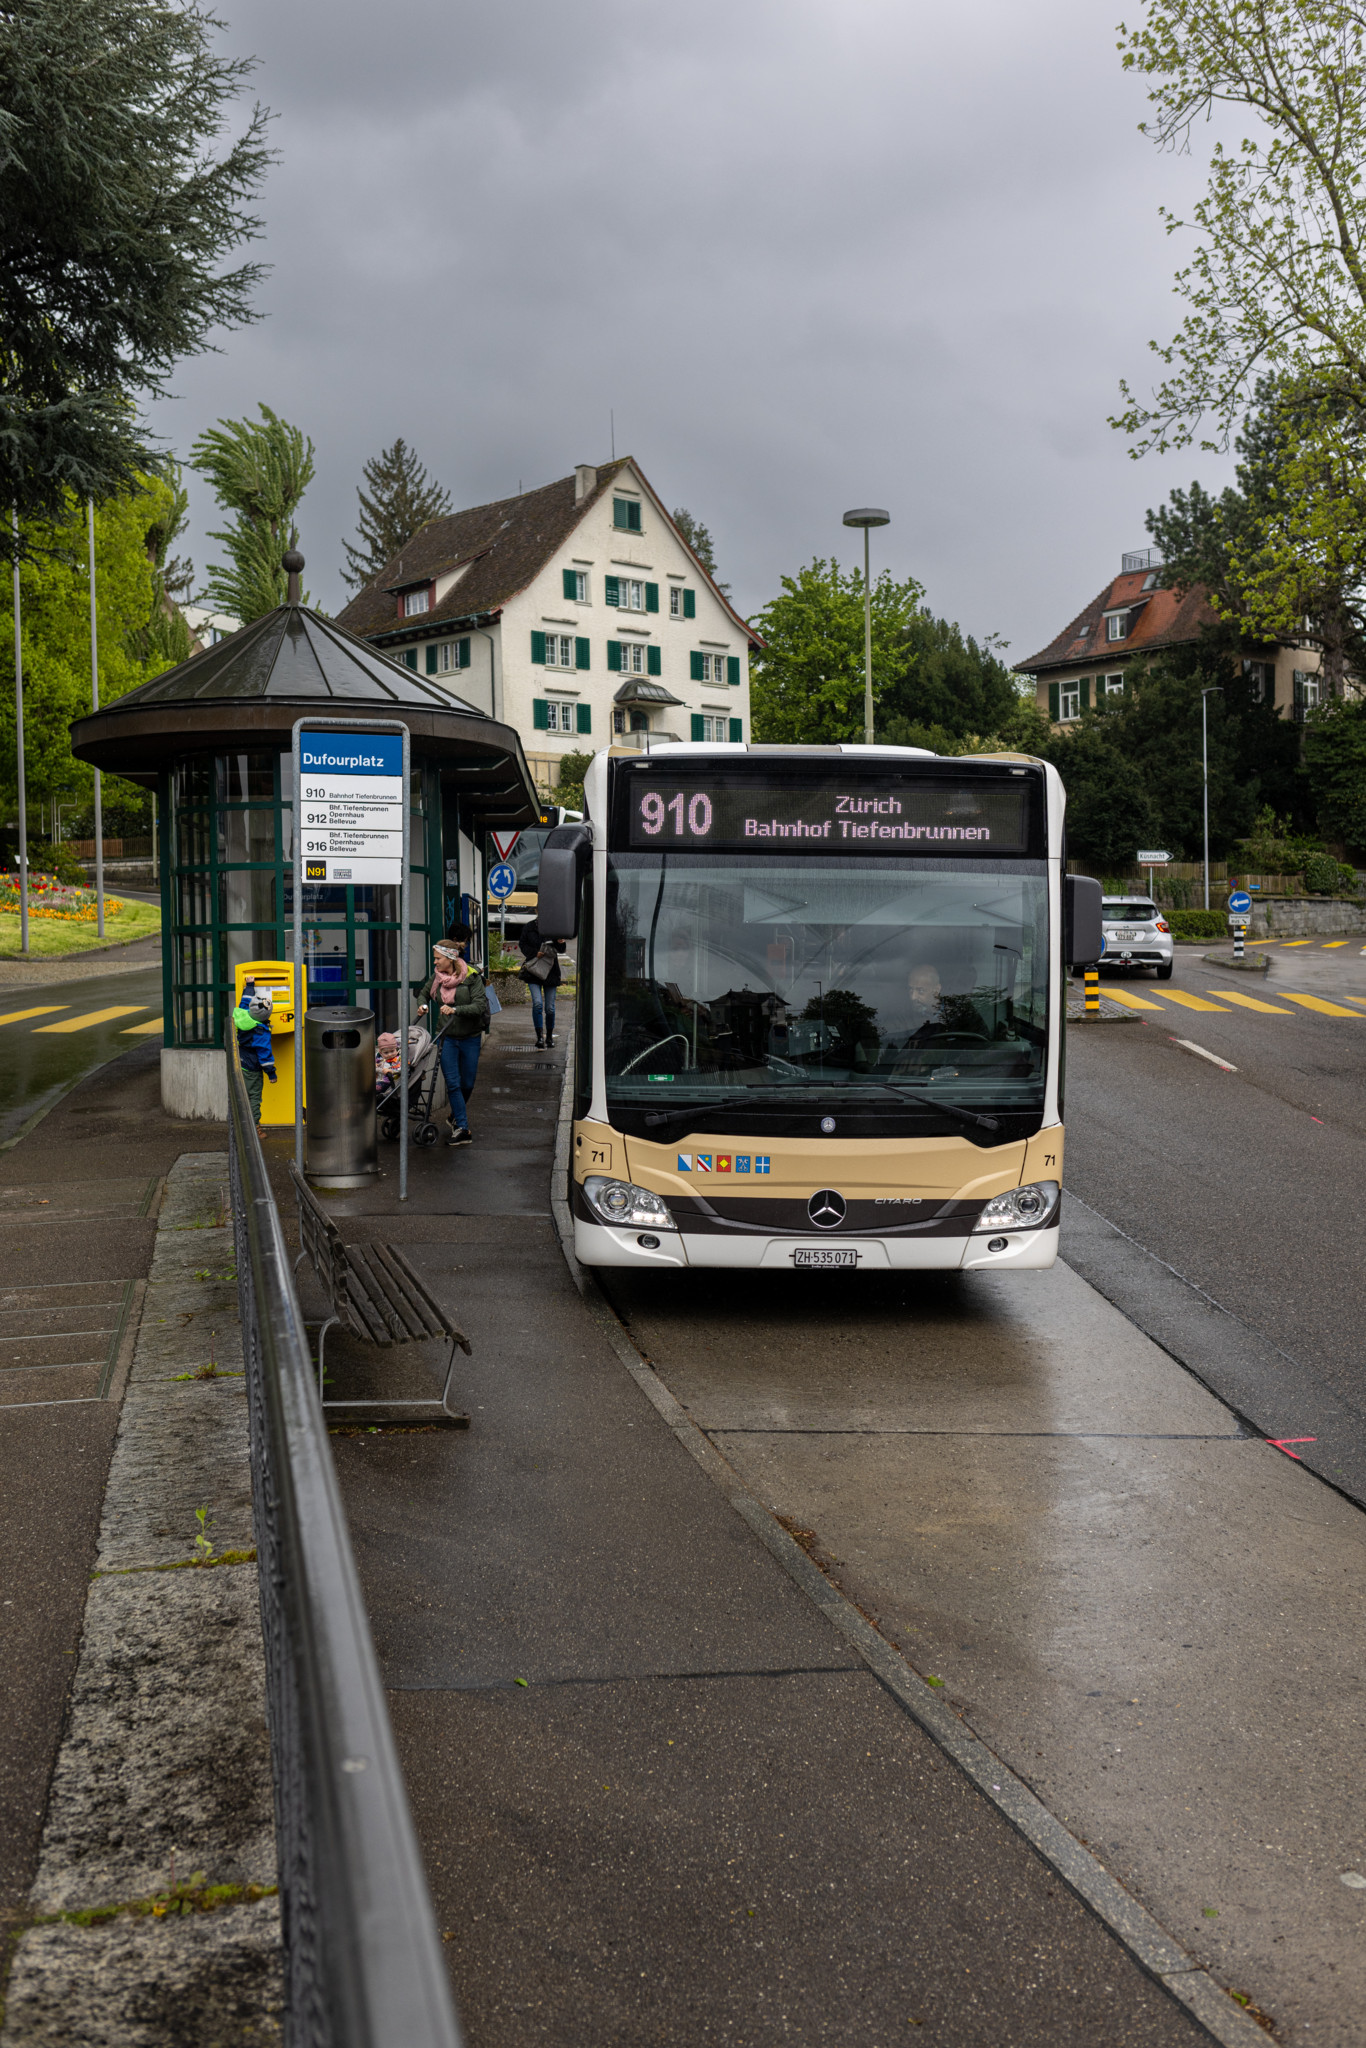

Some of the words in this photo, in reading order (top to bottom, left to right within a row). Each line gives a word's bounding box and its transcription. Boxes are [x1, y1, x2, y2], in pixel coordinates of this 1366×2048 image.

[303, 752, 384, 768] Dufourplatz
[306, 788, 326, 798] 910
[836, 796, 902, 814] Zürich
[307, 814, 327, 824] 912
[642, 792, 712, 835] 910
[745, 819, 832, 837] Bahnhof
[838, 820, 990, 840] Tiefenbrunnen
[306, 842, 327, 852] 916
[307, 867, 325, 876] N91
[592, 1150, 604, 1162] 71
[1044, 1154, 1055, 1166] 71
